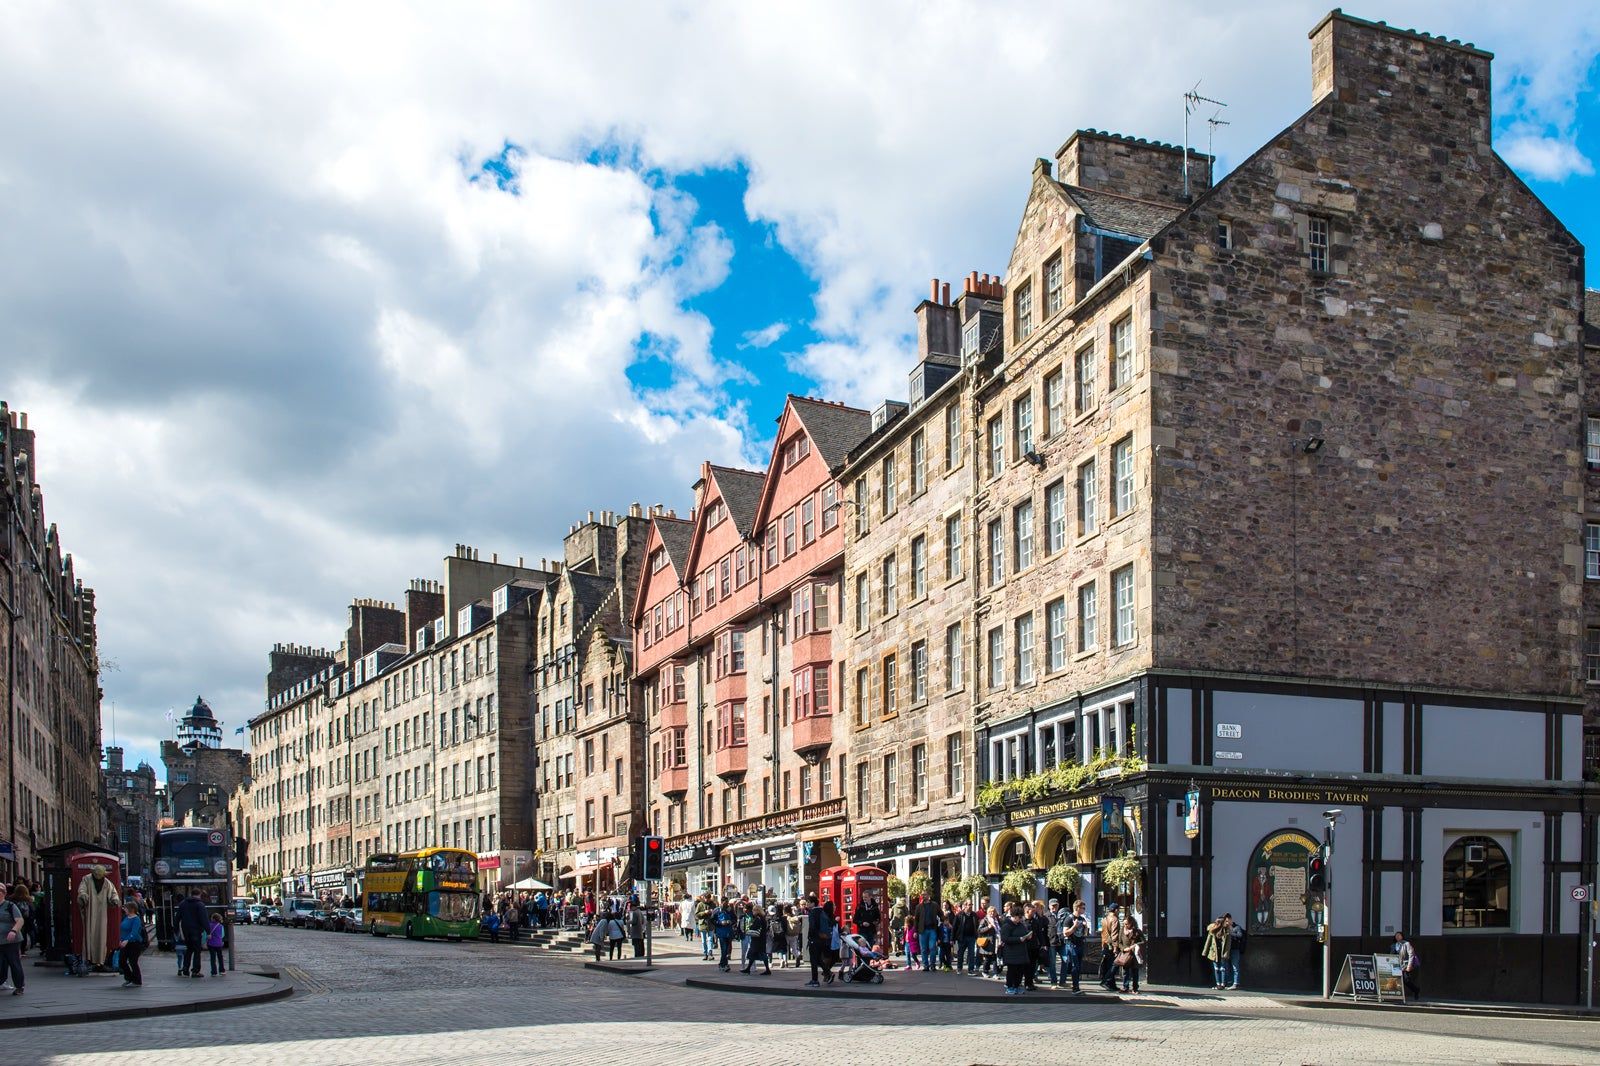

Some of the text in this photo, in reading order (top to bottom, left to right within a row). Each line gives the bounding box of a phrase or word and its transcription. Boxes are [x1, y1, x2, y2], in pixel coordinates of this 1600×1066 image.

[1211, 787, 1369, 802] DEACON BRODIE'S TAVERN
[1010, 795, 1099, 821] DEACON BRODIE'S TAVERN
[1355, 980, 1375, 990] £100
